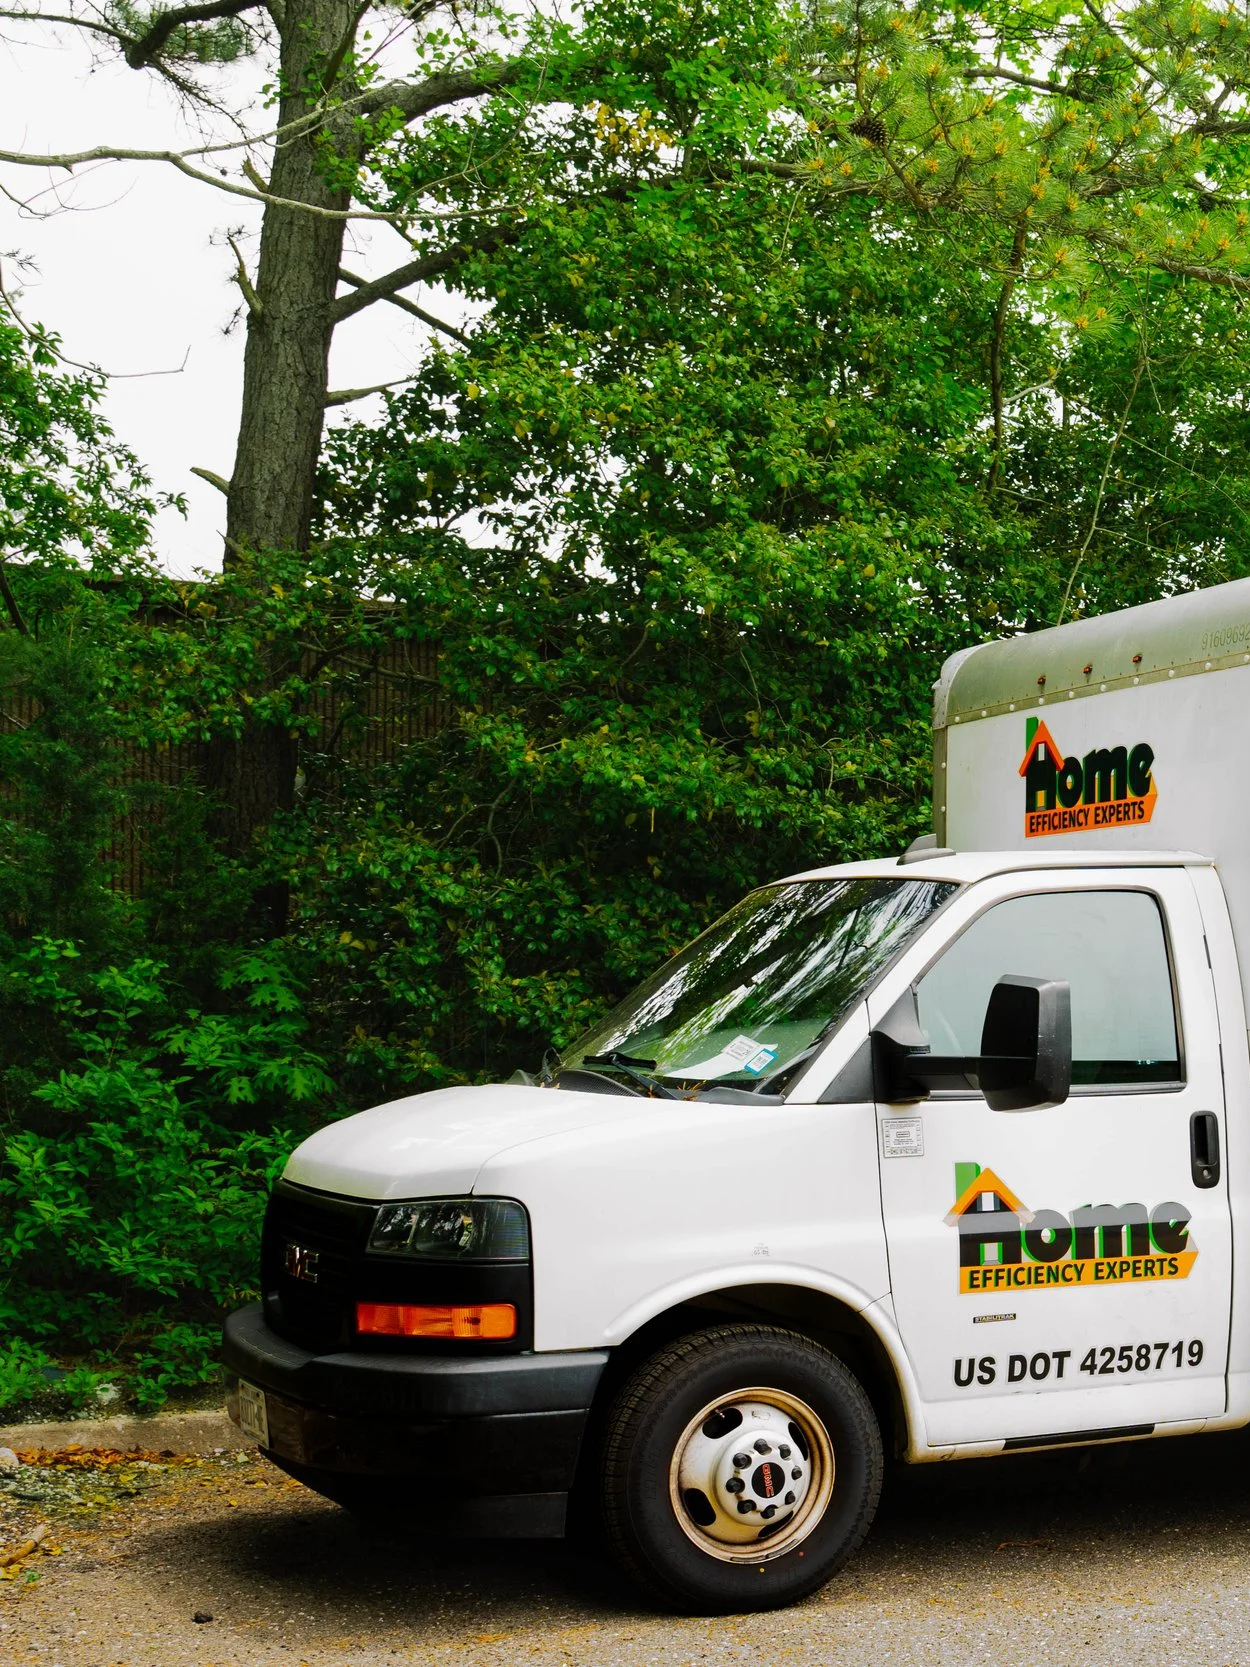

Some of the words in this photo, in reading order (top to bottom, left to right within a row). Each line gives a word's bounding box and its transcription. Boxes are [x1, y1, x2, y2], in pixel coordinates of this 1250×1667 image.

[1029, 808, 1089, 834] EFFICIENCY
[1094, 800, 1145, 825] EXPERTS
[968, 1263, 1085, 1289] EFFICIENCY
[1094, 1257, 1179, 1281] EXPERTS
[954, 1356, 996, 1387] US
[1007, 1350, 1071, 1383] DOT
[1080, 1339, 1204, 1376] 4258719
[762, 1463, 775, 1498] GMC
